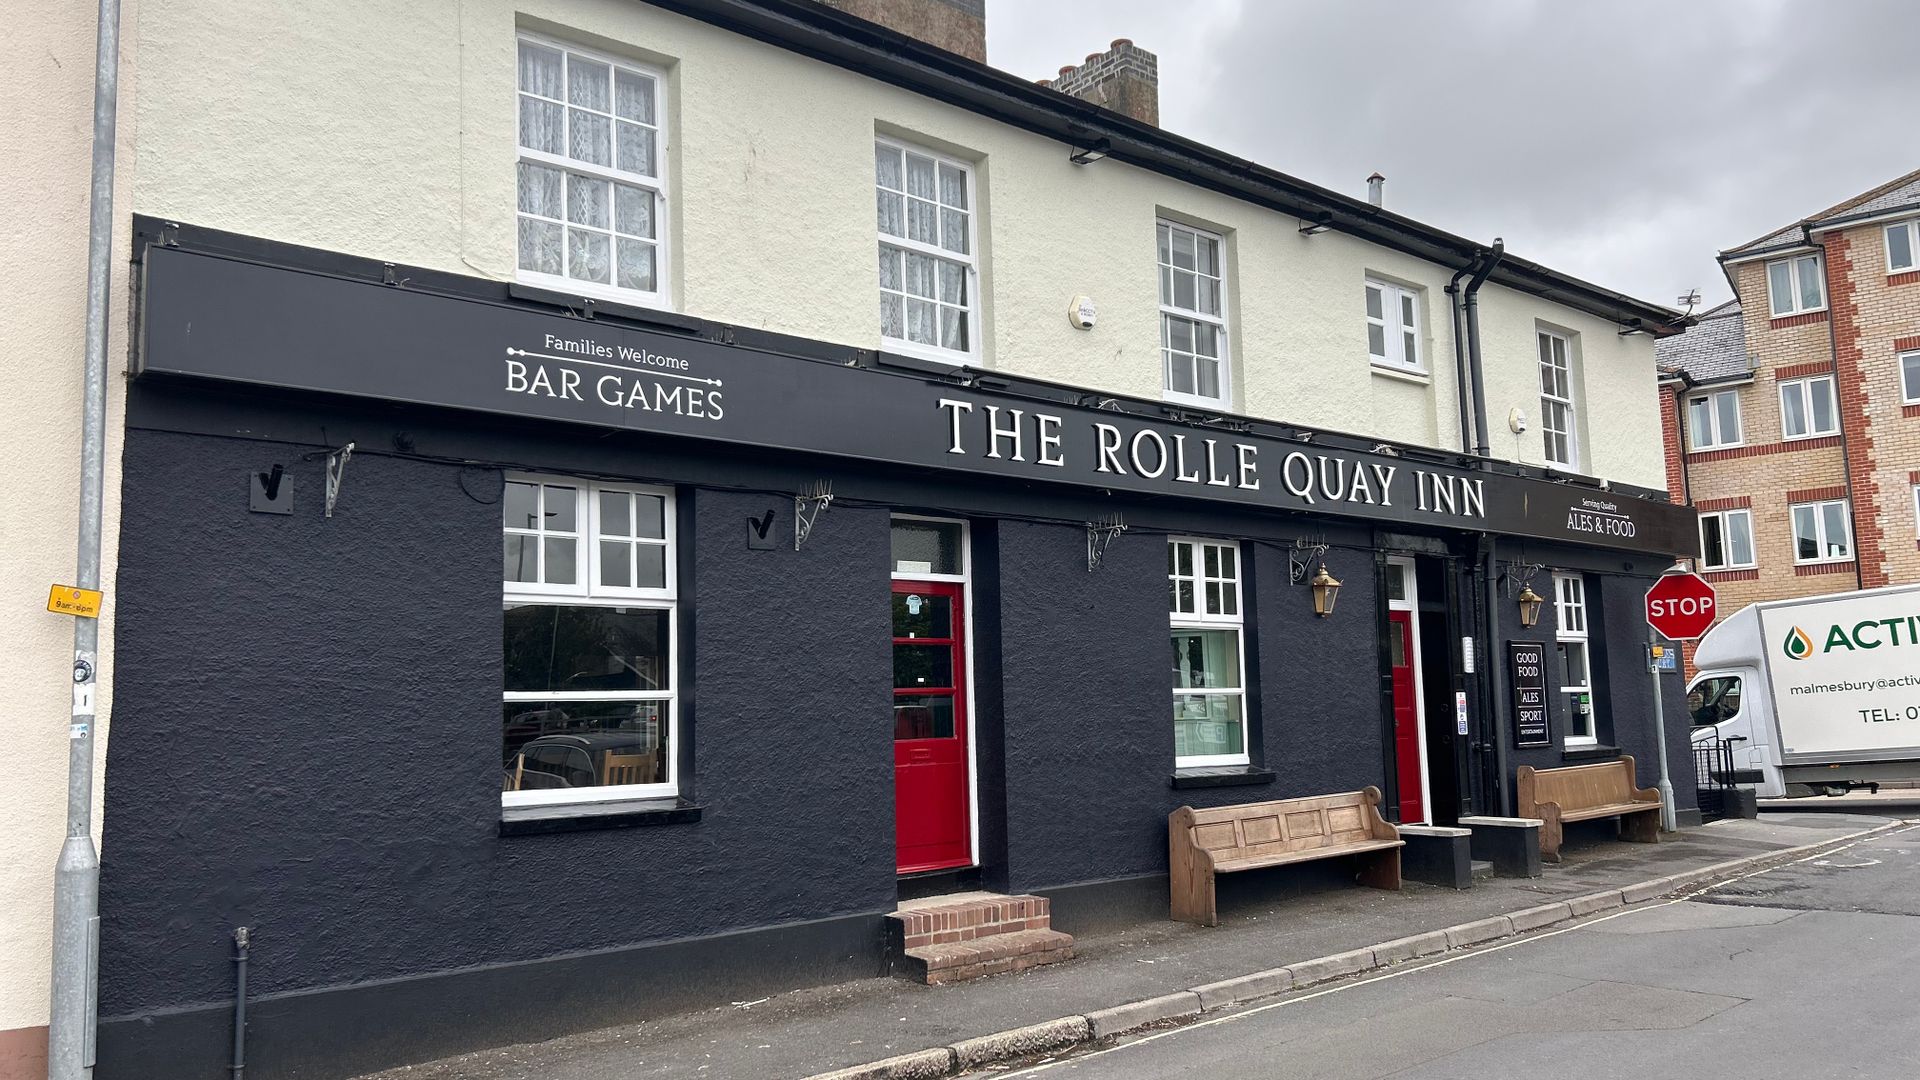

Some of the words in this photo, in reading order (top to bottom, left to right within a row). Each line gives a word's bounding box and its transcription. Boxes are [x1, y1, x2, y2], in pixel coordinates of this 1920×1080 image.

[544, 334, 613, 358] Families
[618, 346, 689, 371] Welcome
[505, 359, 584, 401] BAR
[596, 375, 724, 420] GAMES
[938, 398, 1064, 467] THE
[1094, 422, 1260, 490] ROLLE
[1282, 451, 1396, 506] QUAY
[1414, 470, 1485, 518] INN
[1582, 498, 1600, 510] Serving
[1600, 501, 1617, 513] Quality
[1567, 512, 1593, 532] ALES
[1595, 516, 1604, 534] &
[1606, 518, 1636, 537] FOOD
[1650, 596, 1713, 617] STOP
[1823, 615, 1920, 653] ACTI
[1516, 653, 1538, 664] GOOD
[1518, 666, 1538, 677] FOOD
[1522, 692, 1539, 703] ALES
[1520, 710, 1543, 721] SPORT
[1859, 708, 1900, 722] TEL:
